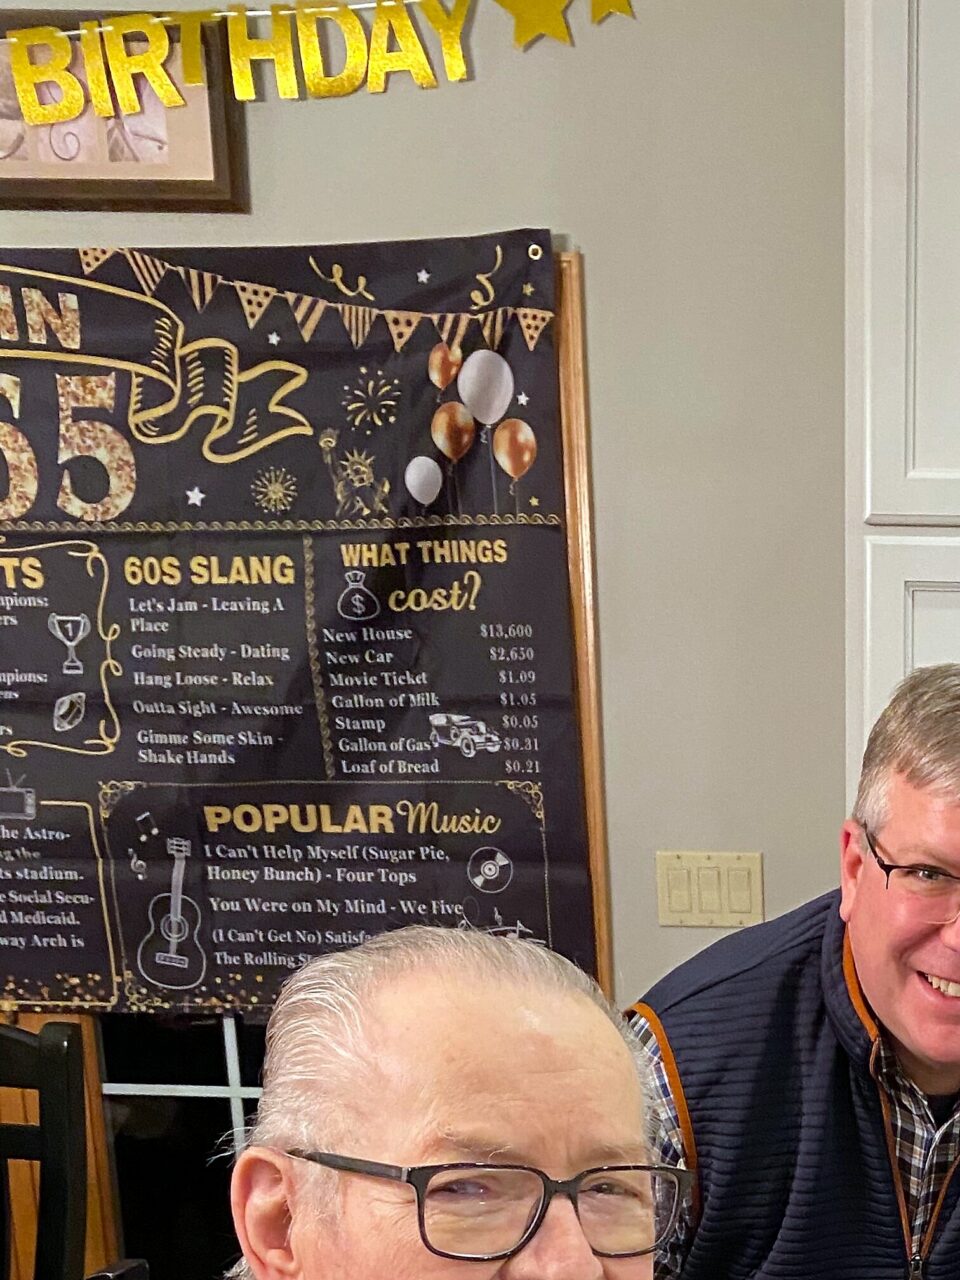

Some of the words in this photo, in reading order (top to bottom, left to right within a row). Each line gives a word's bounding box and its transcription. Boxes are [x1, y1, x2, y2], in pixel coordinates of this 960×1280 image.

[7, 0, 472, 126] BIRTHDAY
[340, 542, 411, 567] WHAT
[417, 539, 508, 564] THINGS
[124, 556, 182, 585] 60S
[190, 556, 296, 585] SLANG
[388, 570, 482, 612] cost?
[129, 598, 164, 612] Let's
[167, 598, 198, 613] Jam
[211, 597, 270, 614] Leaving
[273, 598, 285, 611] A
[130, 617, 169, 632] Place
[322, 628, 358, 642] New
[362, 627, 413, 641] House
[131, 644, 175, 661] Going
[178, 644, 227, 661] Steady
[240, 644, 290, 660] Dating
[325, 651, 360, 664] New
[364, 649, 394, 663] Car
[133, 671, 172, 688] Hang
[175, 671, 218, 685] Loose
[231, 671, 274, 686] Relax
[329, 672, 378, 686] Movie
[380, 671, 428, 686] Ticket
[499, 670, 536, 684] $1.09
[132, 700, 175, 715] Outta
[178, 700, 217, 717] Sight
[231, 701, 303, 715] Awesome
[331, 694, 385, 708] Gallon
[389, 693, 405, 707] of
[409, 692, 441, 707] Milk
[500, 692, 537, 706] $1.05
[335, 716, 386, 733] Stamp
[502, 715, 539, 729] $0.05
[136, 729, 188, 745] Gimme
[193, 730, 235, 745] Some
[237, 731, 273, 746] Skin
[338, 738, 387, 752] Gallon
[390, 738, 405, 751] of
[406, 738, 432, 751] Gas
[138, 749, 184, 764] Shake
[186, 750, 236, 764] Hands
[341, 759, 377, 774] Loaf
[379, 760, 395, 773] of
[397, 759, 440, 773] Bread
[505, 759, 540, 774] $0.21
[203, 804, 394, 834] POPULAR
[396, 800, 502, 835] Music
[23, 827, 71, 840] Astro-
[15, 846, 40, 859] the
[204, 844, 212, 857] I
[215, 844, 259, 859] Can't
[263, 844, 302, 863] Help
[307, 845, 359, 863] Myself
[362, 846, 416, 863] (Sugar
[420, 846, 450, 862] Pie,
[16, 865, 84, 880] stadium.
[207, 865, 259, 884] Honey
[264, 866, 321, 883] Bunch)
[336, 867, 374, 882] Four
[377, 868, 417, 886] Tops
[8, 889, 52, 904] Social
[55, 890, 95, 904] Secu-
[209, 897, 241, 912] You
[244, 897, 288, 912] Were
[292, 902, 312, 913] on
[316, 899, 340, 917] My
[345, 899, 387, 914] Mind
[400, 900, 427, 914] We
[431, 900, 464, 915] Five
[10, 911, 81, 925] Medicaid.
[31, 934, 67, 948] Arch
[70, 934, 85, 948] is
[212, 928, 223, 943] (I
[227, 928, 264, 943] Can't
[267, 929, 293, 943] Get
[295, 929, 321, 945] No)
[214, 951, 241, 965] The
[243, 951, 296, 969] Rolling
